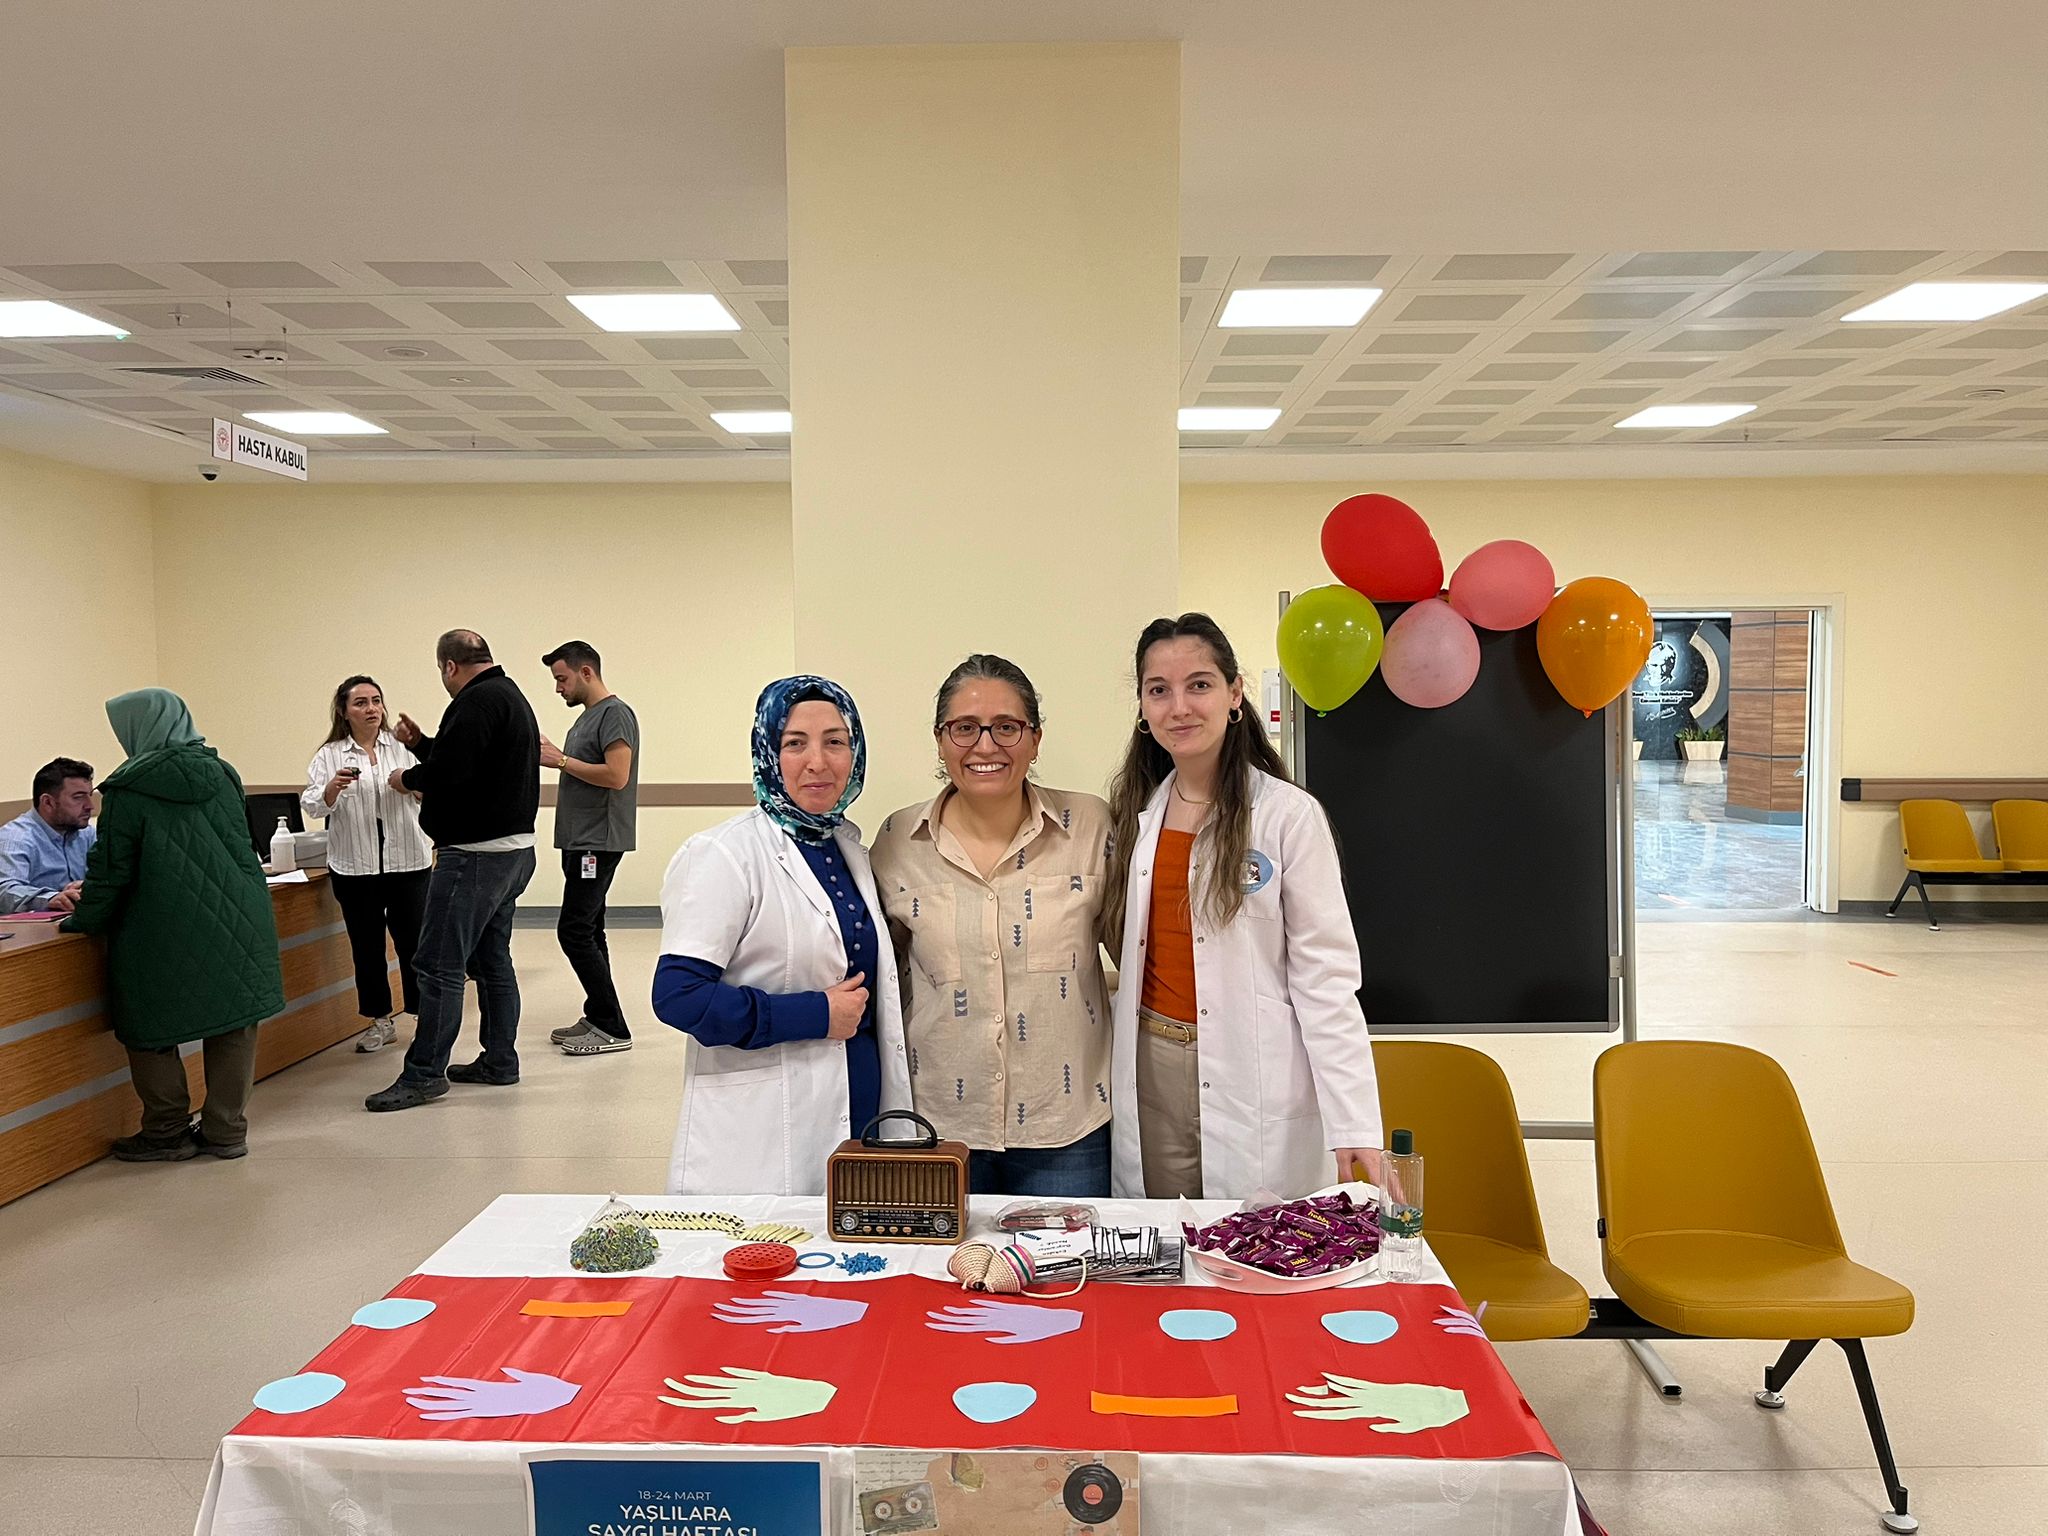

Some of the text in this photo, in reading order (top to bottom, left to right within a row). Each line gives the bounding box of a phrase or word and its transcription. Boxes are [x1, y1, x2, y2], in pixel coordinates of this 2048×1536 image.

[238, 435, 306, 471] HASTA KABUL
[1308, 1210, 1331, 1225] hobby
[1290, 1257, 1309, 1266] hobby
[638, 1490, 712, 1501] 18-24 MART
[619, 1504, 732, 1523] YAŞLILARA
